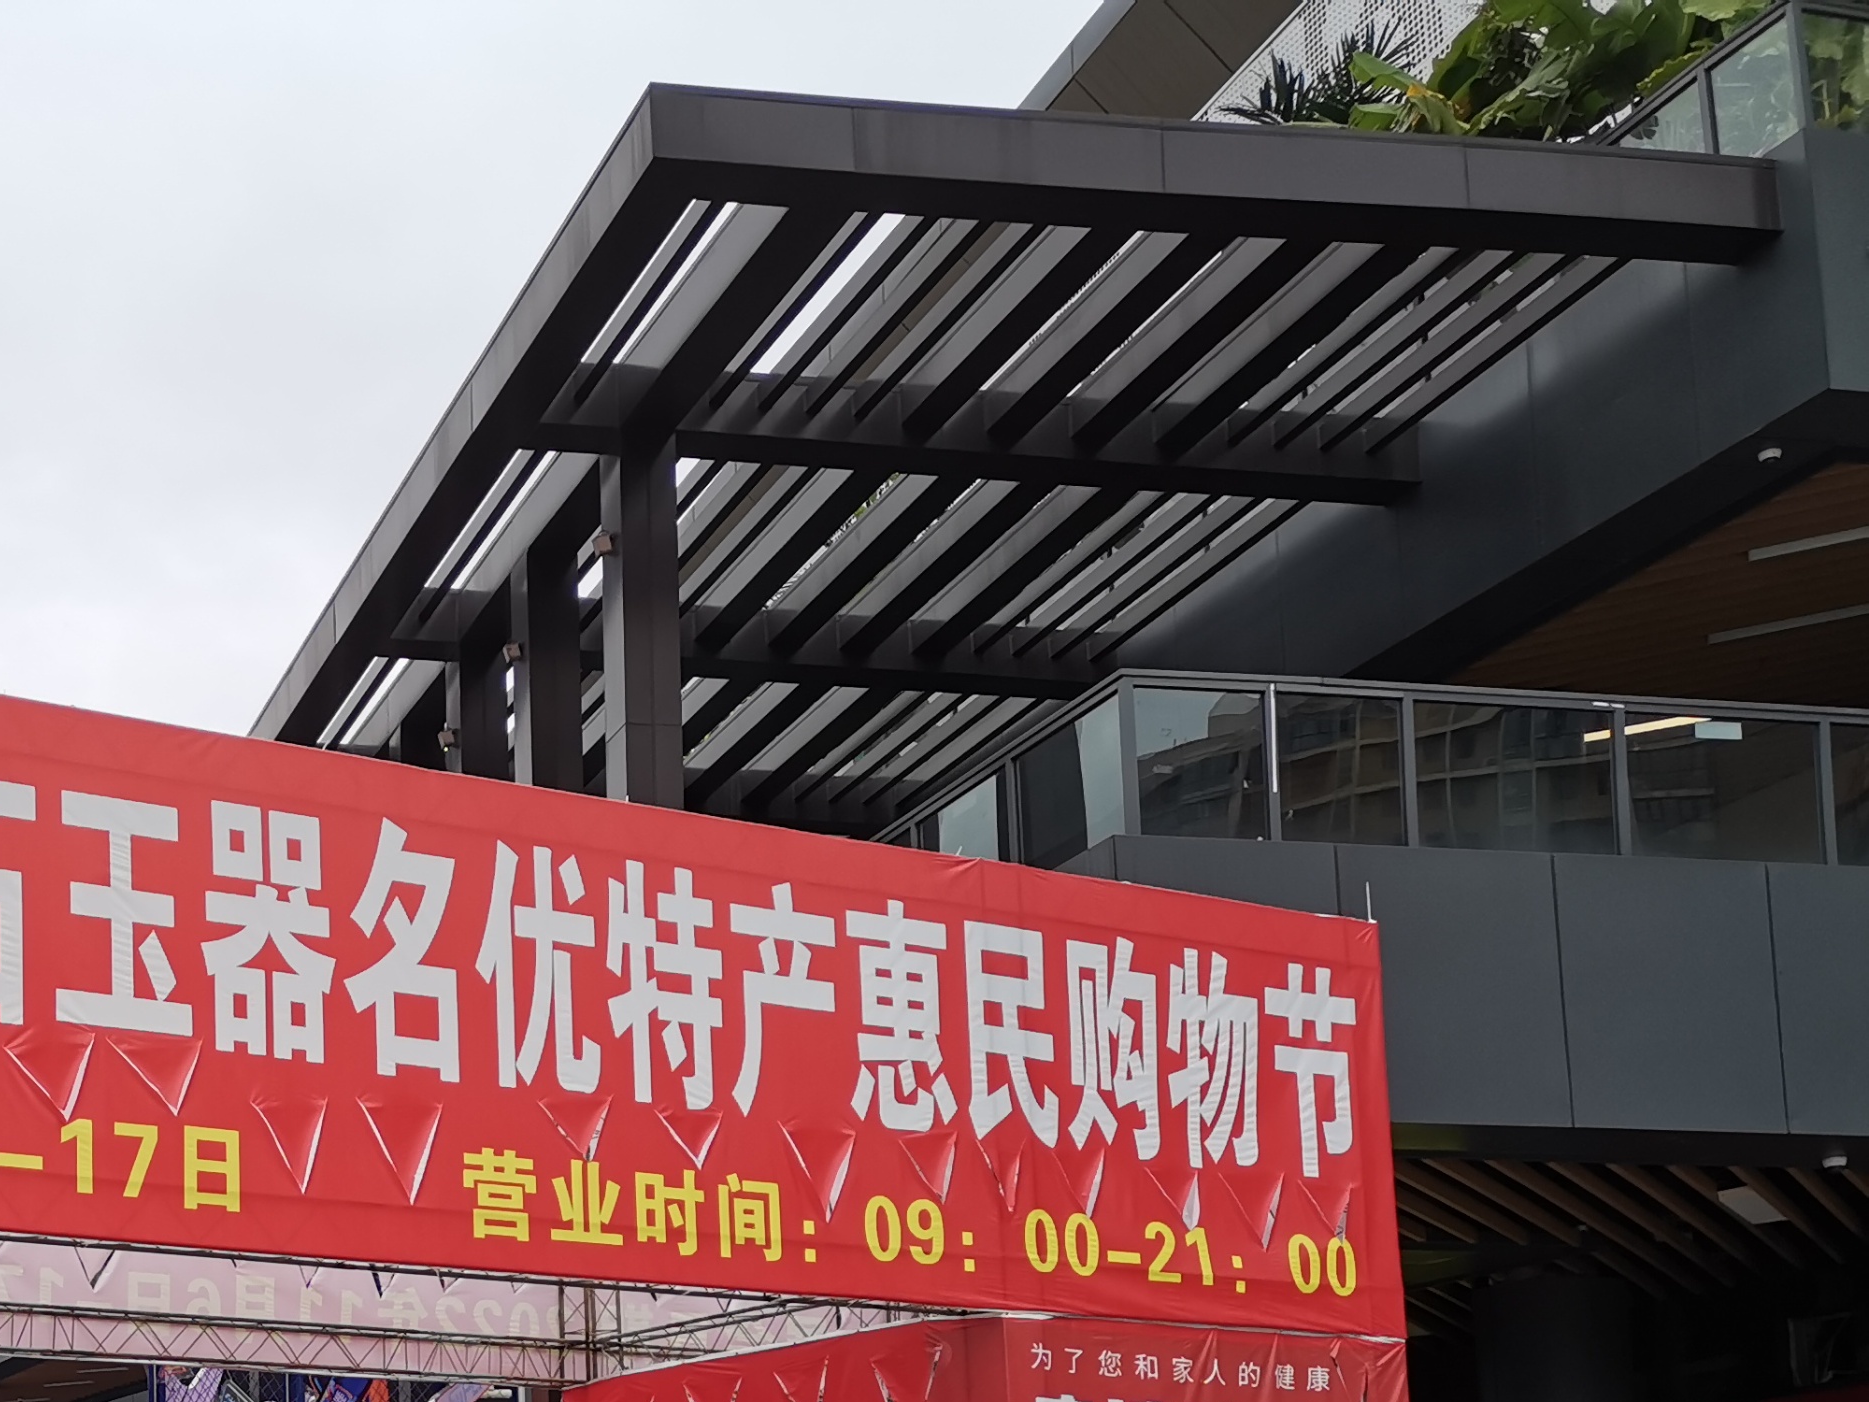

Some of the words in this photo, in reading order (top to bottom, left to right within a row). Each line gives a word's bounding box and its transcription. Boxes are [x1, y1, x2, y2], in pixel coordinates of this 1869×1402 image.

[1030, 1343, 1331, 1392] 为了您和家人的健康
